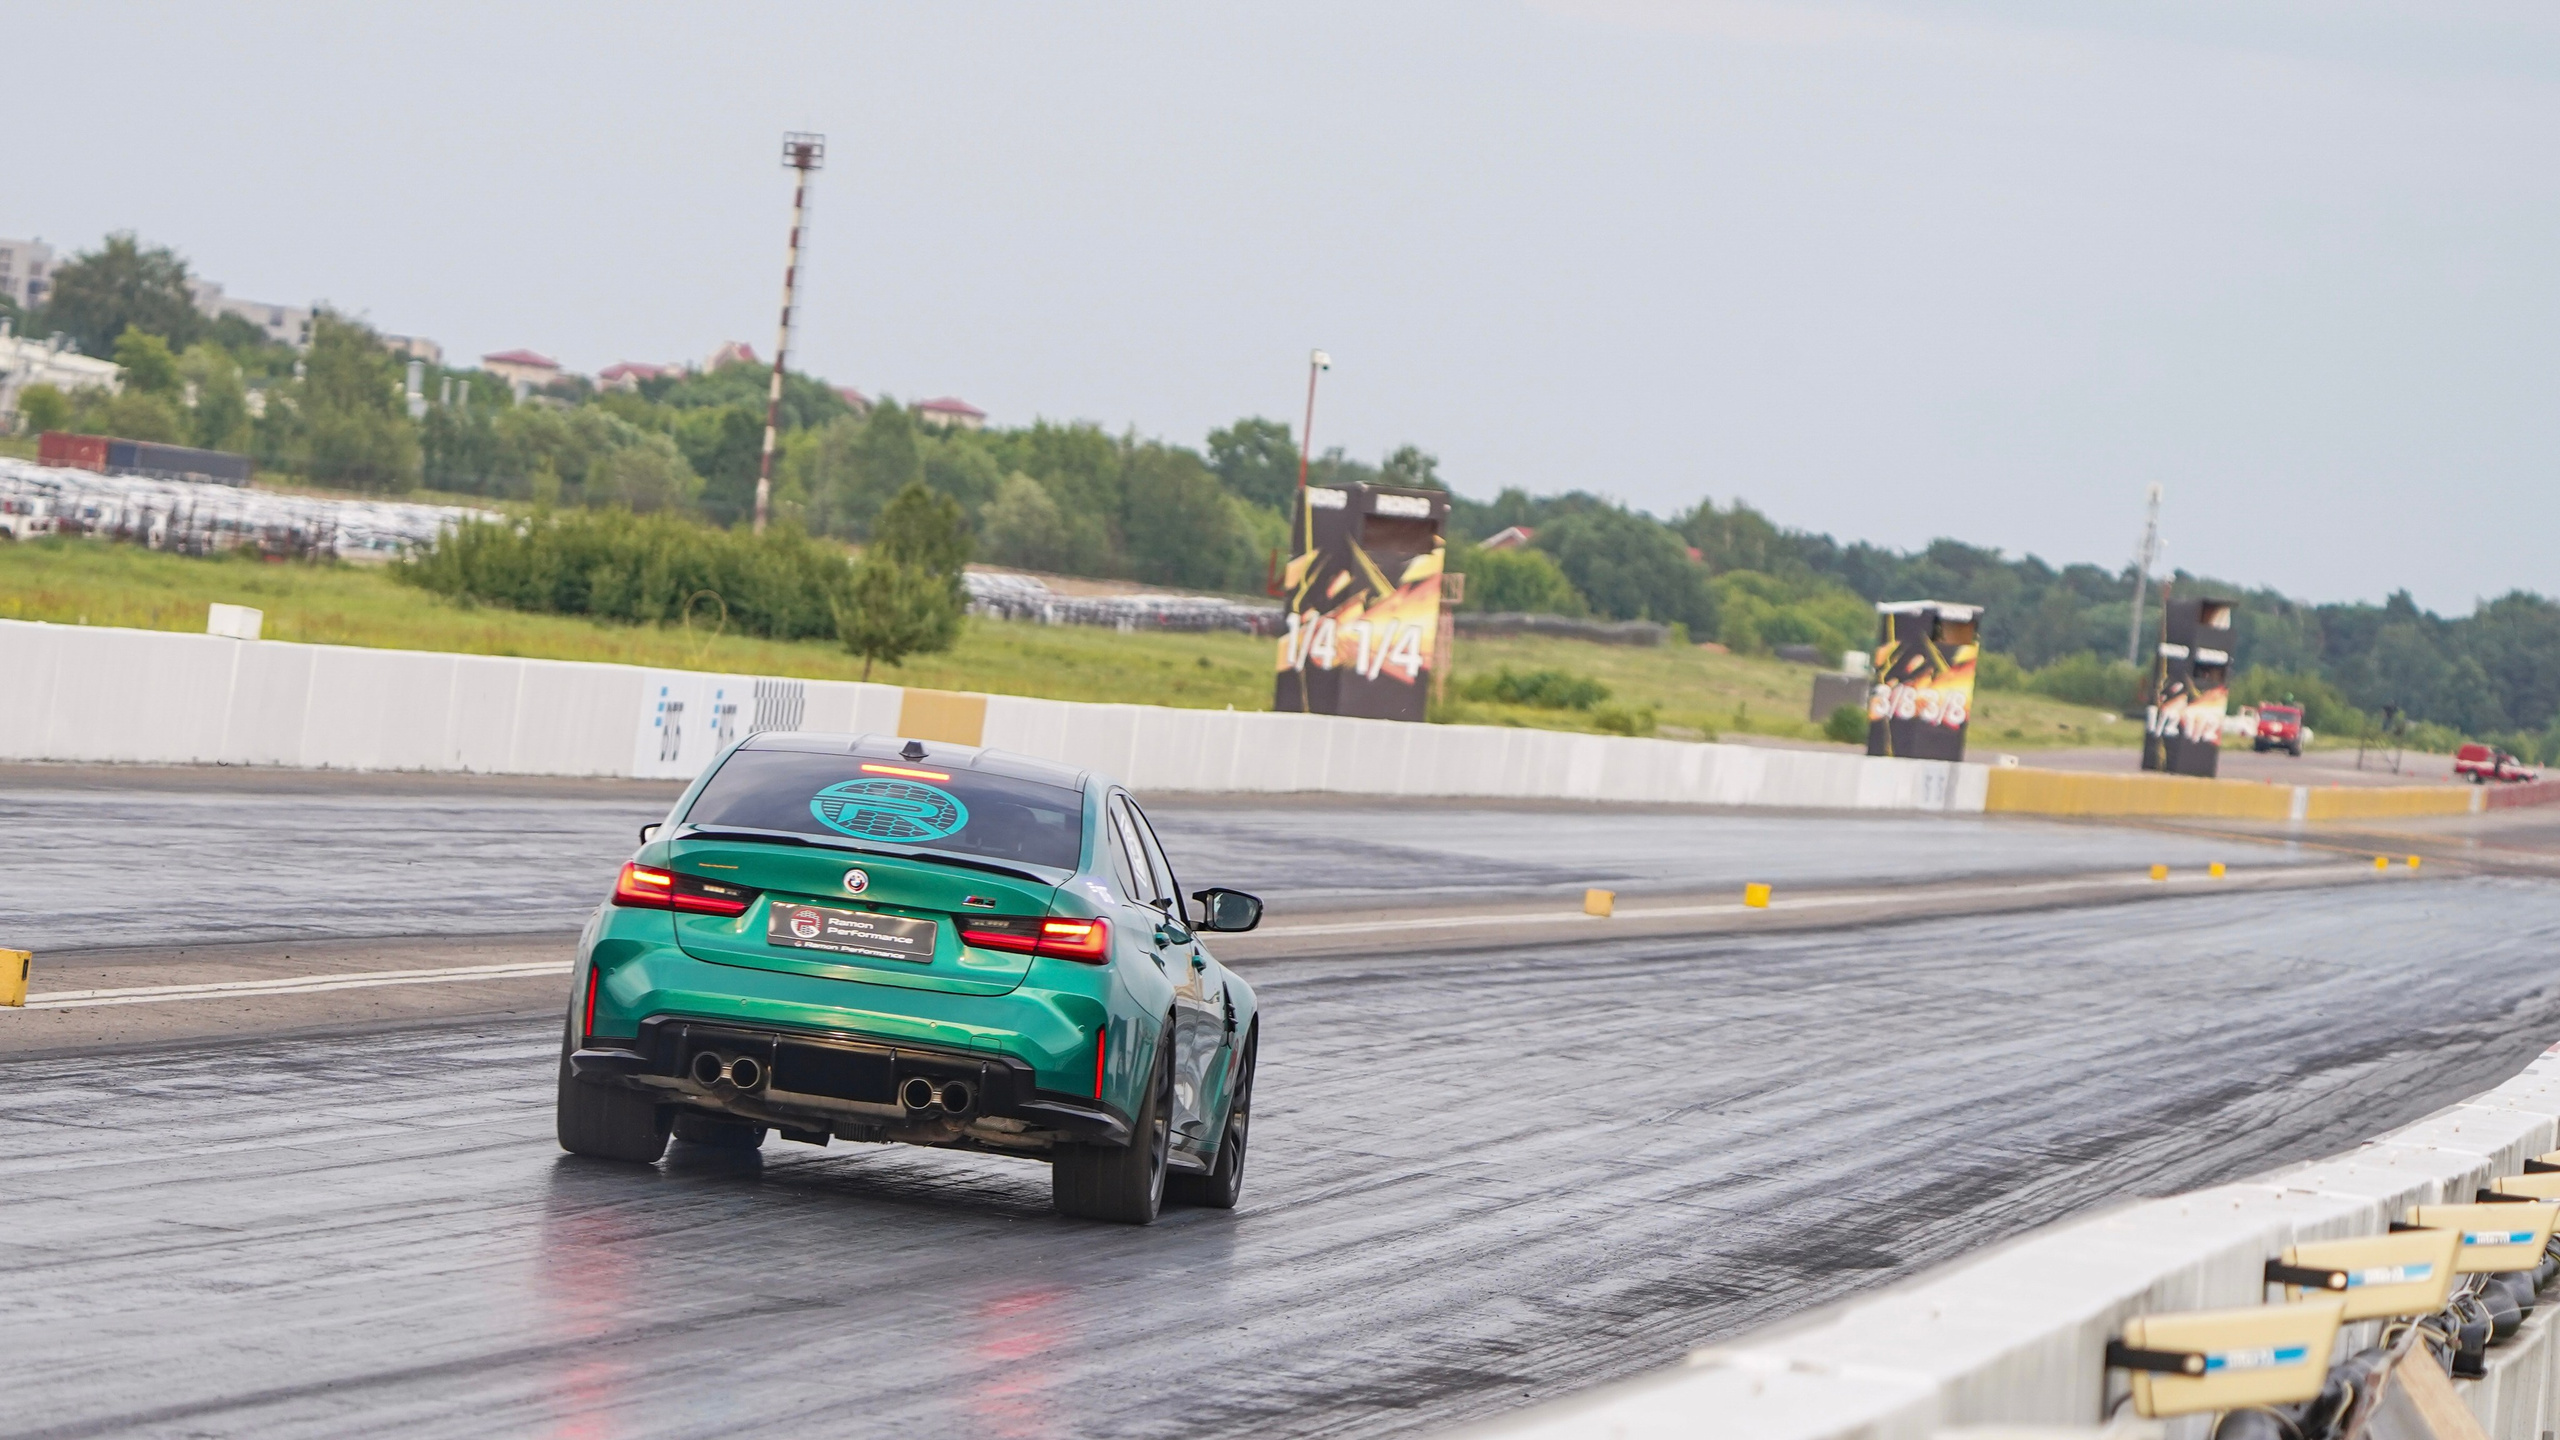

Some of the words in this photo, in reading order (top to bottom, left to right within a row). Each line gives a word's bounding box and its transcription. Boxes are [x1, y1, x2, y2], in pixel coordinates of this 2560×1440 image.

[1287, 610, 1337, 672] 1/4
[1352, 617, 1423, 682] 1/4
[1873, 682, 1917, 720] 3/8
[1919, 687, 1967, 726] 3/8
[827, 926, 914, 944] Performance
[828, 918, 874, 930] Ramon
[804, 942, 839, 951] Ramon
[841, 946, 906, 960] Performance
